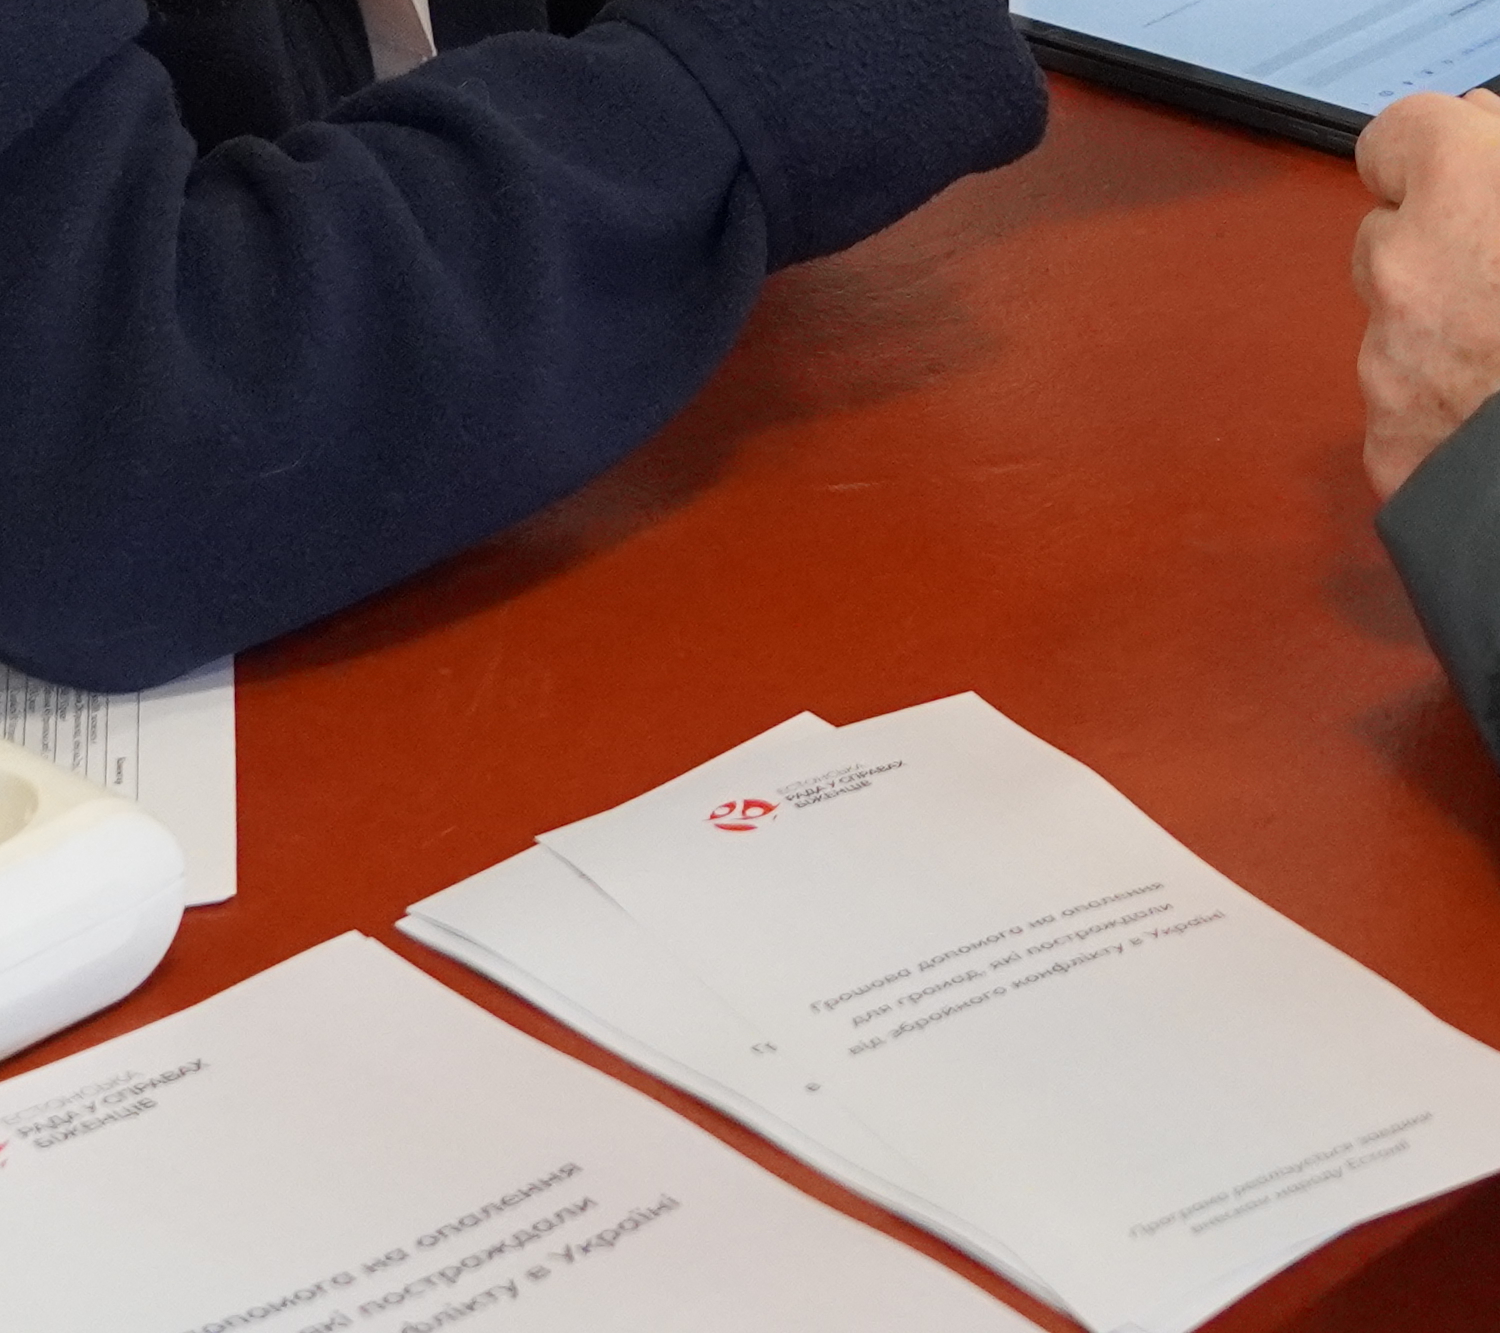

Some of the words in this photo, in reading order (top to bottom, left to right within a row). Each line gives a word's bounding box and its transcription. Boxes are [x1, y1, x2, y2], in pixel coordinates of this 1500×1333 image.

[809, 967, 913, 1014] Грошова
[917, 923, 1024, 973] допомога
[1028, 914, 1057, 929] на
[1061, 880, 1165, 918] опалення
[848, 1036, 887, 1056] від
[890, 986, 1008, 1038] збройного
[1011, 942, 1125, 990] конфлікту
[1129, 936, 1143, 947] в
[1149, 910, 1227, 939] Україні
[850, 1001, 894, 1027] для
[989, 949, 1024, 972] які
[1025, 902, 1175, 958] постраждали
[17, 1110, 80, 1138] РАДА
[85, 1101, 97, 1112] У
[102, 1058, 211, 1105] СПРАВАХ
[33, 1097, 159, 1150] БІЖЕНЦІВ
[183, 1271, 357, 1333] опомога
[361, 1245, 409, 1276] на
[414, 1161, 583, 1251] опалення
[358, 1196, 598, 1319] постраждали
[525, 1263, 551, 1283] в
[547, 1191, 682, 1269] Україні
